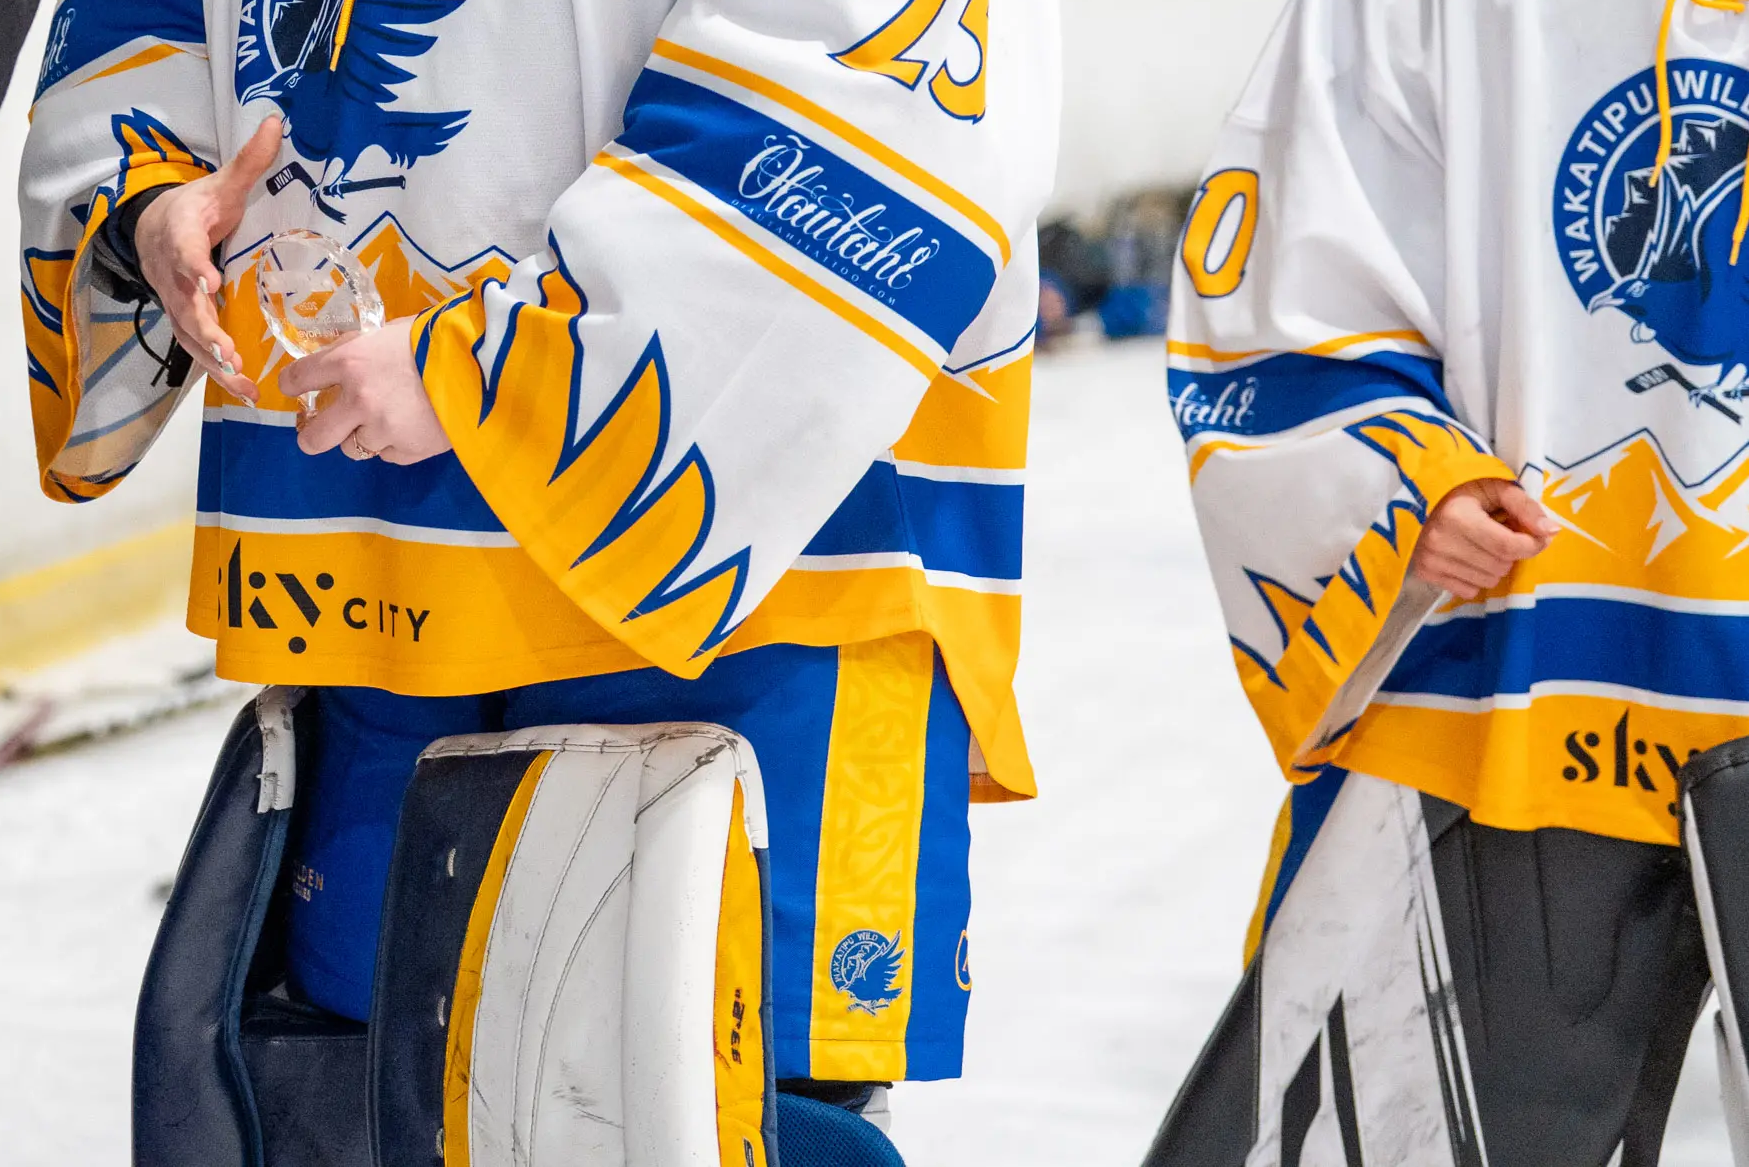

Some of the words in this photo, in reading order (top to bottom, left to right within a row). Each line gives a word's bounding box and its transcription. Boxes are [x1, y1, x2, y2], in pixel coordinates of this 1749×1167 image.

[1562, 82, 1654, 284] WAKATIPU
[217, 538, 335, 654] ky
[342, 597, 431, 642] CITY
